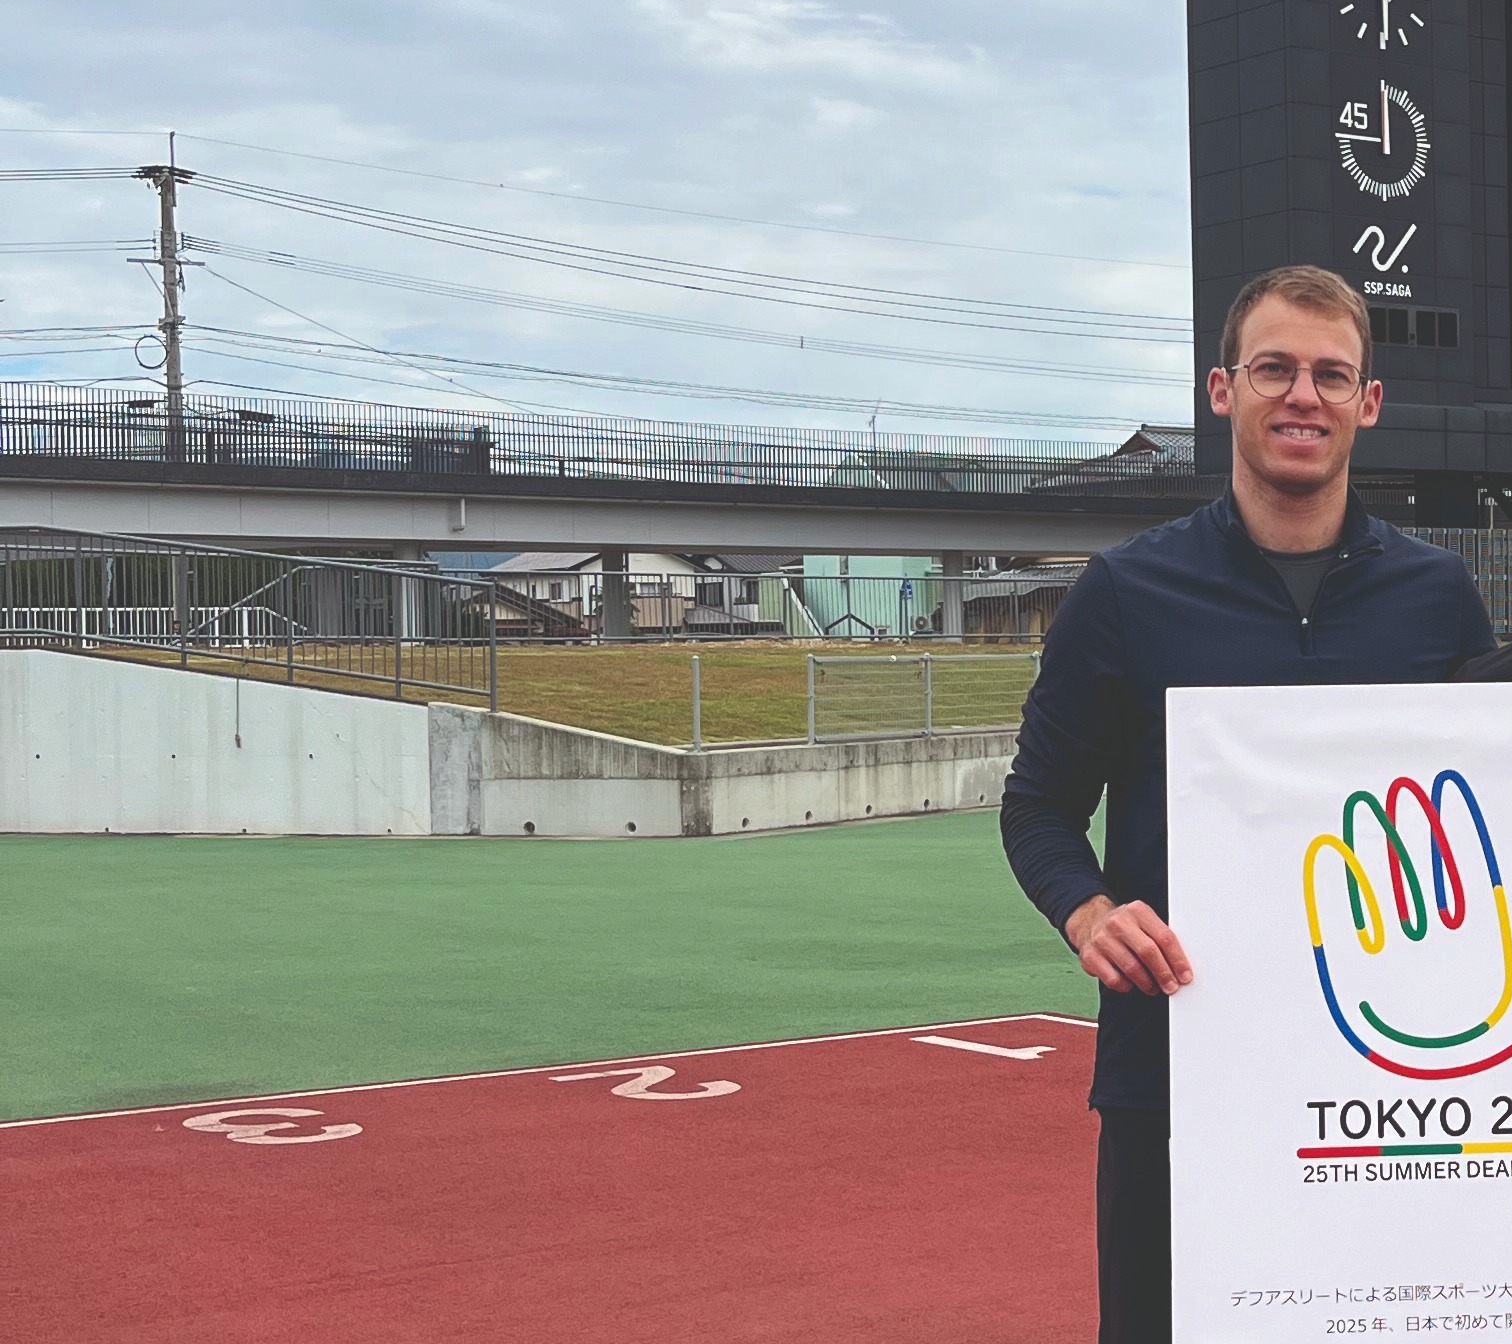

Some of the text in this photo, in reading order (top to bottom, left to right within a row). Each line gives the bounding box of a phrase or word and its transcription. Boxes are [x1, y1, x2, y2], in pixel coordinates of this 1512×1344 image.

[1339, 101, 1368, 130] 45
[182, 1107, 364, 1145] 3
[1306, 1096, 1472, 1140] TOKYO
[1302, 1162, 1359, 1184] 25TH
[1364, 1160, 1460, 1182] SUMMER
